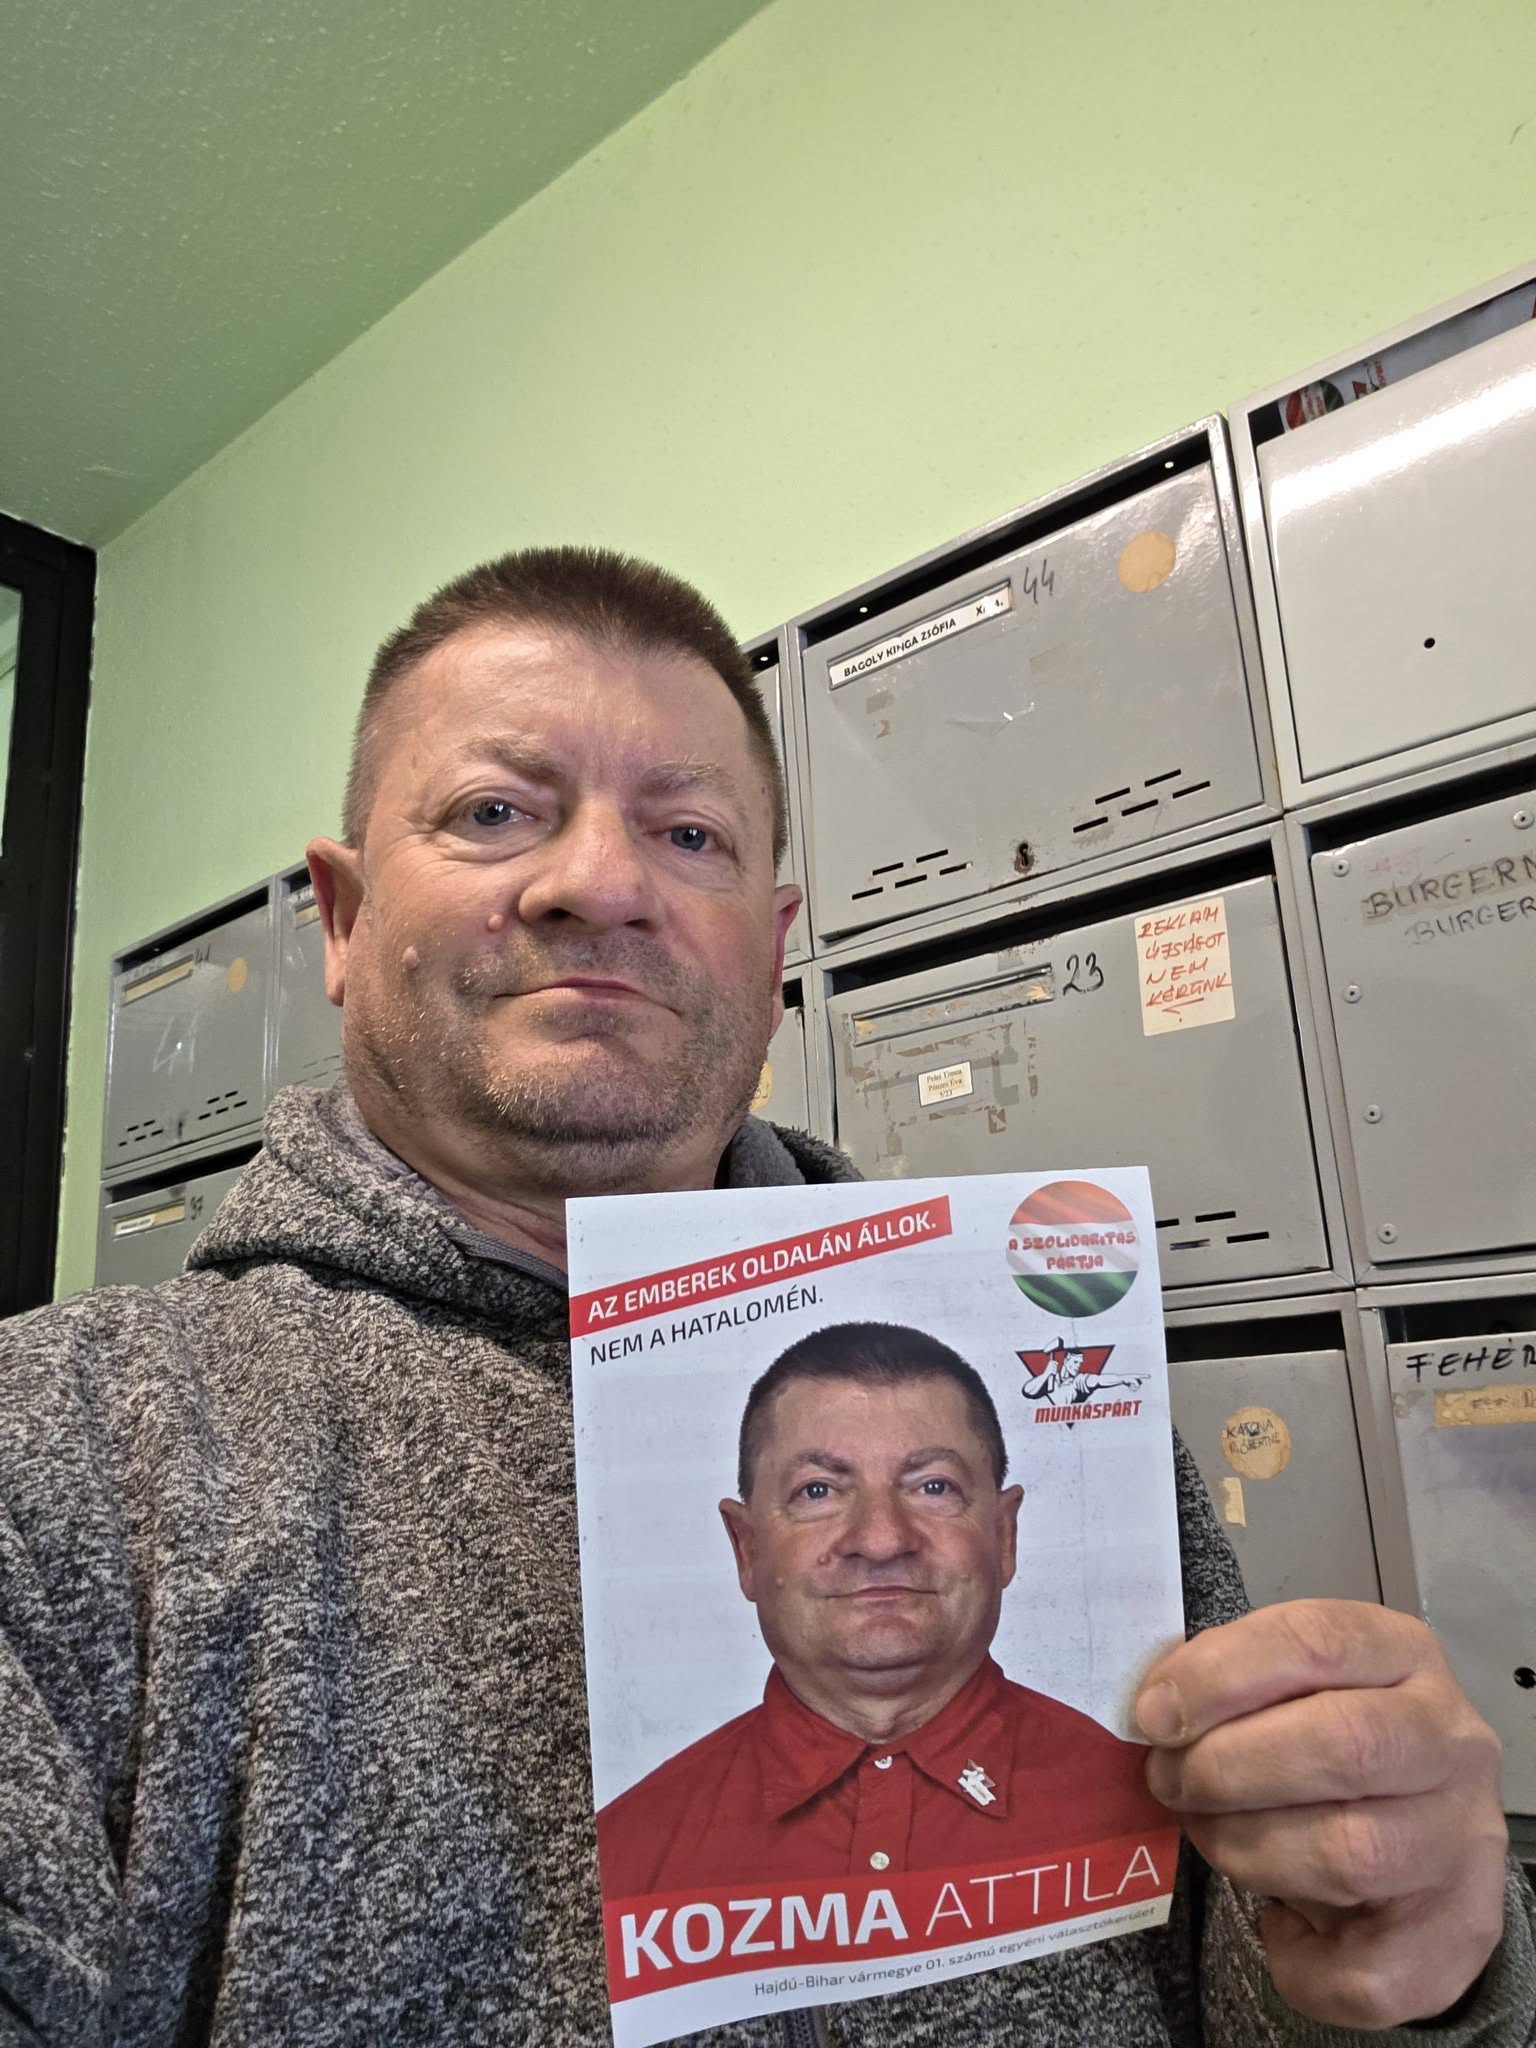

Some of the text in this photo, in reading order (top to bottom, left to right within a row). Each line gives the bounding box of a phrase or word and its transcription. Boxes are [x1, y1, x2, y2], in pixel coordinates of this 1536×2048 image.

[1023, 559, 1055, 604] 44
[843, 653, 885, 678] BAGOLY
[886, 636, 919, 658] KINGA
[920, 618, 957, 642] ZSÓFIA
[1137, 906, 1219, 939] REKLAM
[1062, 951, 1105, 996] 23
[1145, 957, 1209, 985] NEM
[586, 1209, 938, 1324] AZ EMBEREK OLDALÁN ÁLLOK.
[1008, 1238, 1019, 1251] A
[590, 1283, 824, 1367] NEM A HATALOMÉN.
[619, 1845, 1161, 1979] KOZMA ATTILA
[754, 1905, 1156, 1997] Hajdú-Bihar vármegye 01. számú egyéni választókerület
